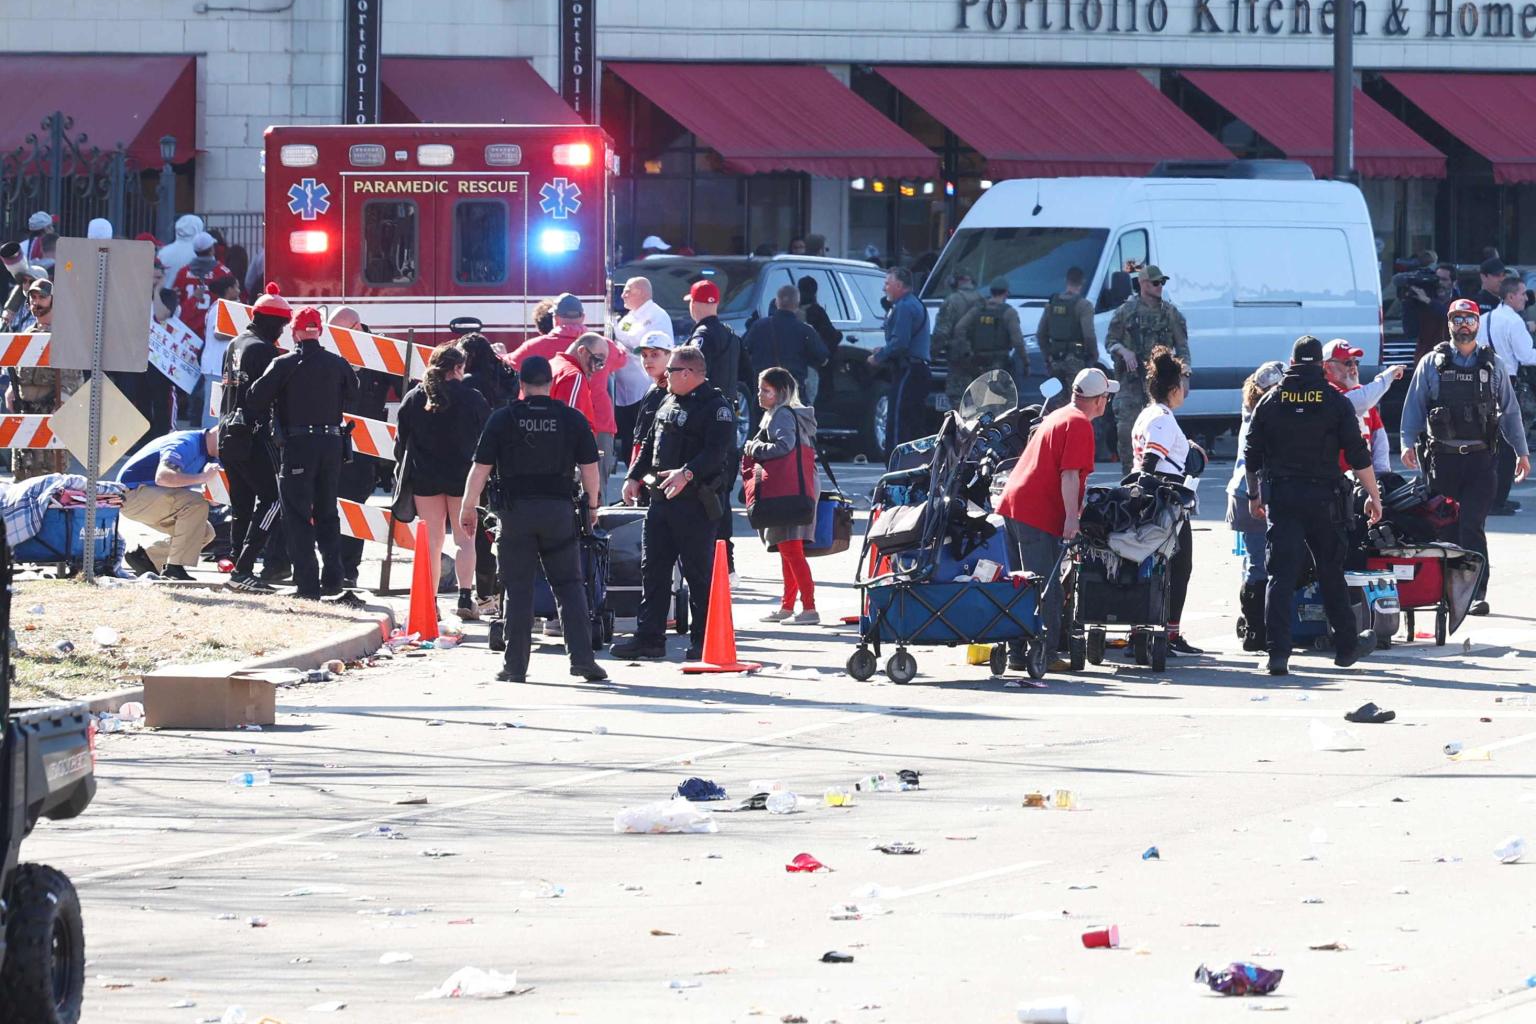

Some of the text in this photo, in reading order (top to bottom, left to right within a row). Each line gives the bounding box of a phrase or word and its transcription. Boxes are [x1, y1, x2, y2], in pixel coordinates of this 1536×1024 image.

[353, 180, 518, 193] PARAMEDIC RESCUE
[519, 419, 557, 433] POLICE
